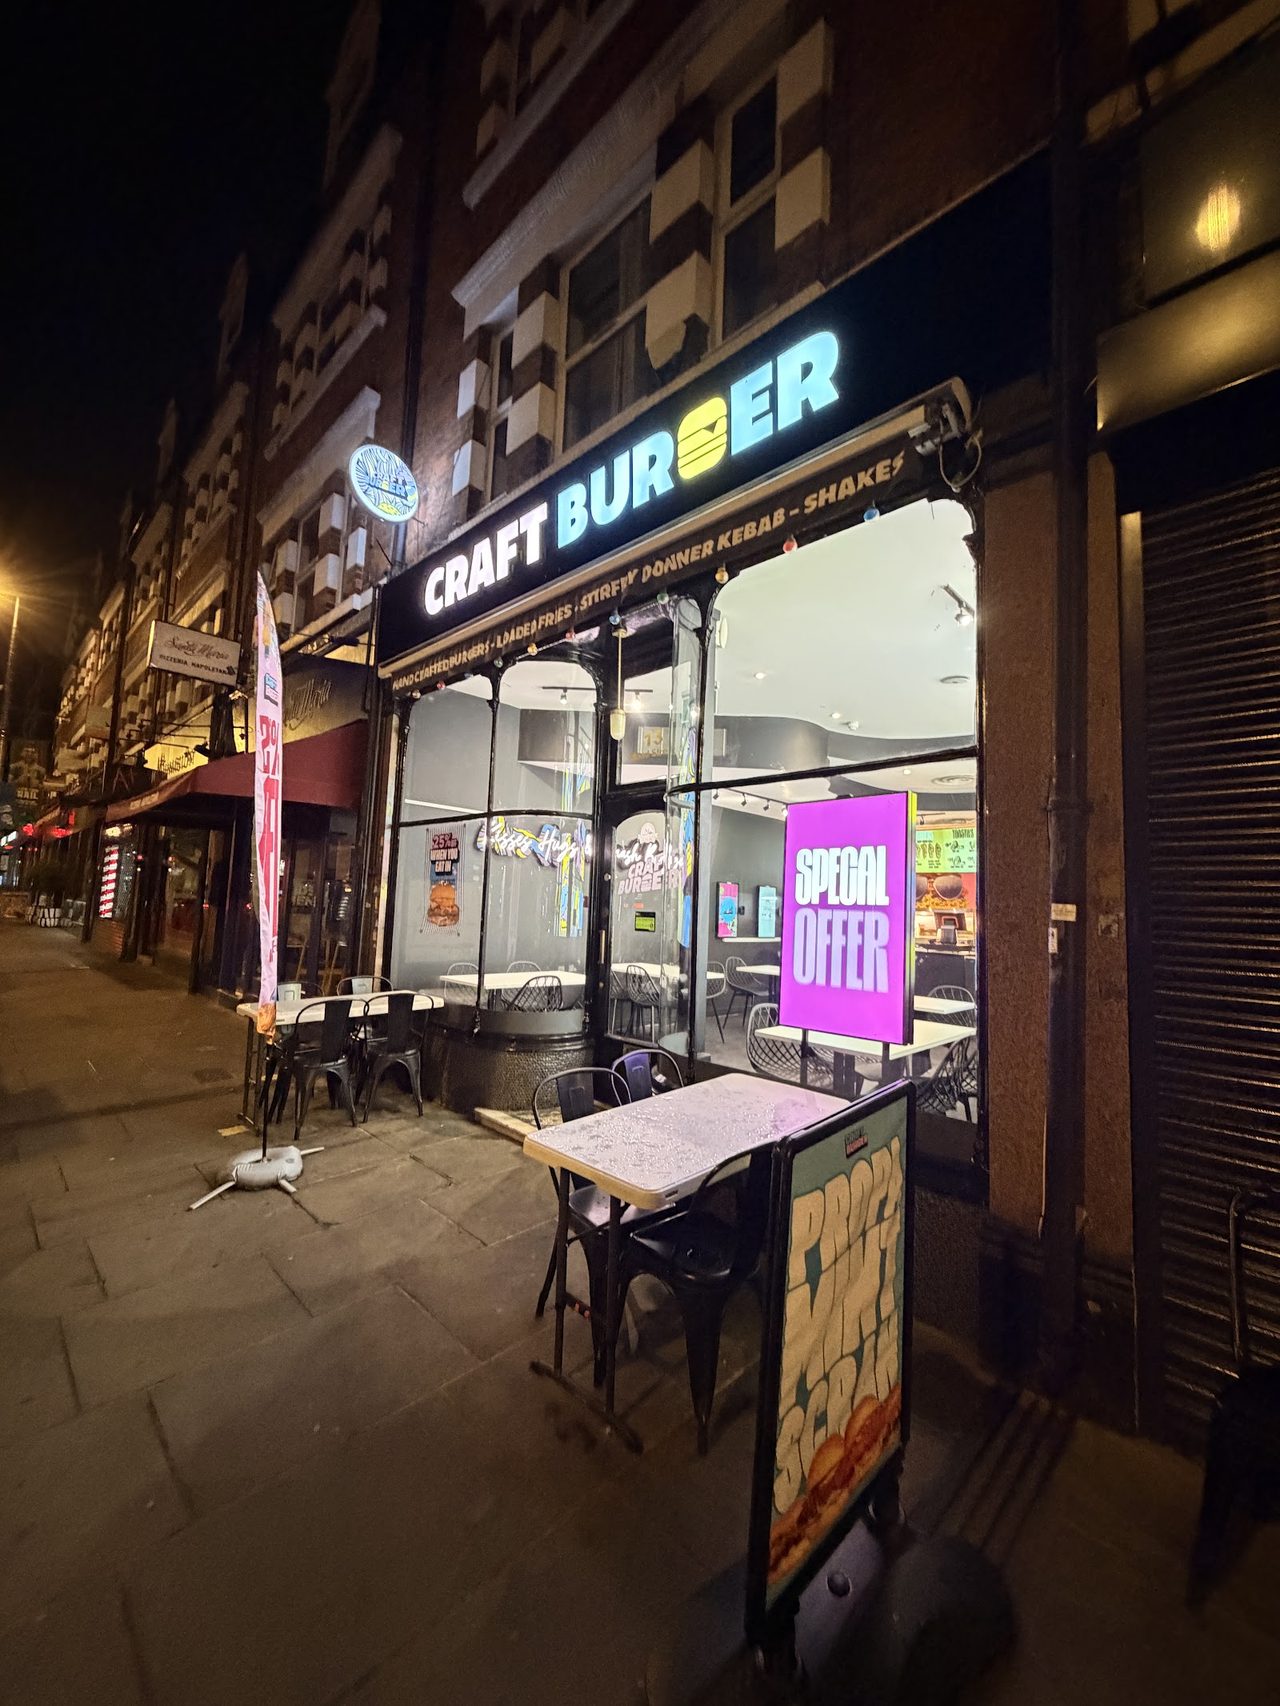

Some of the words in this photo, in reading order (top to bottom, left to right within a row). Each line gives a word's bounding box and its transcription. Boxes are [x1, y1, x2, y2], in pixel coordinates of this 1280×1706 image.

[423, 502, 548, 616] CRAFT
[537, 605, 573, 630] FRIES
[641, 539, 715, 584] DONNER
[716, 506, 786, 551] KEBAB
[803, 450, 905, 515] SHAKES
[793, 907, 890, 994] OFFER
